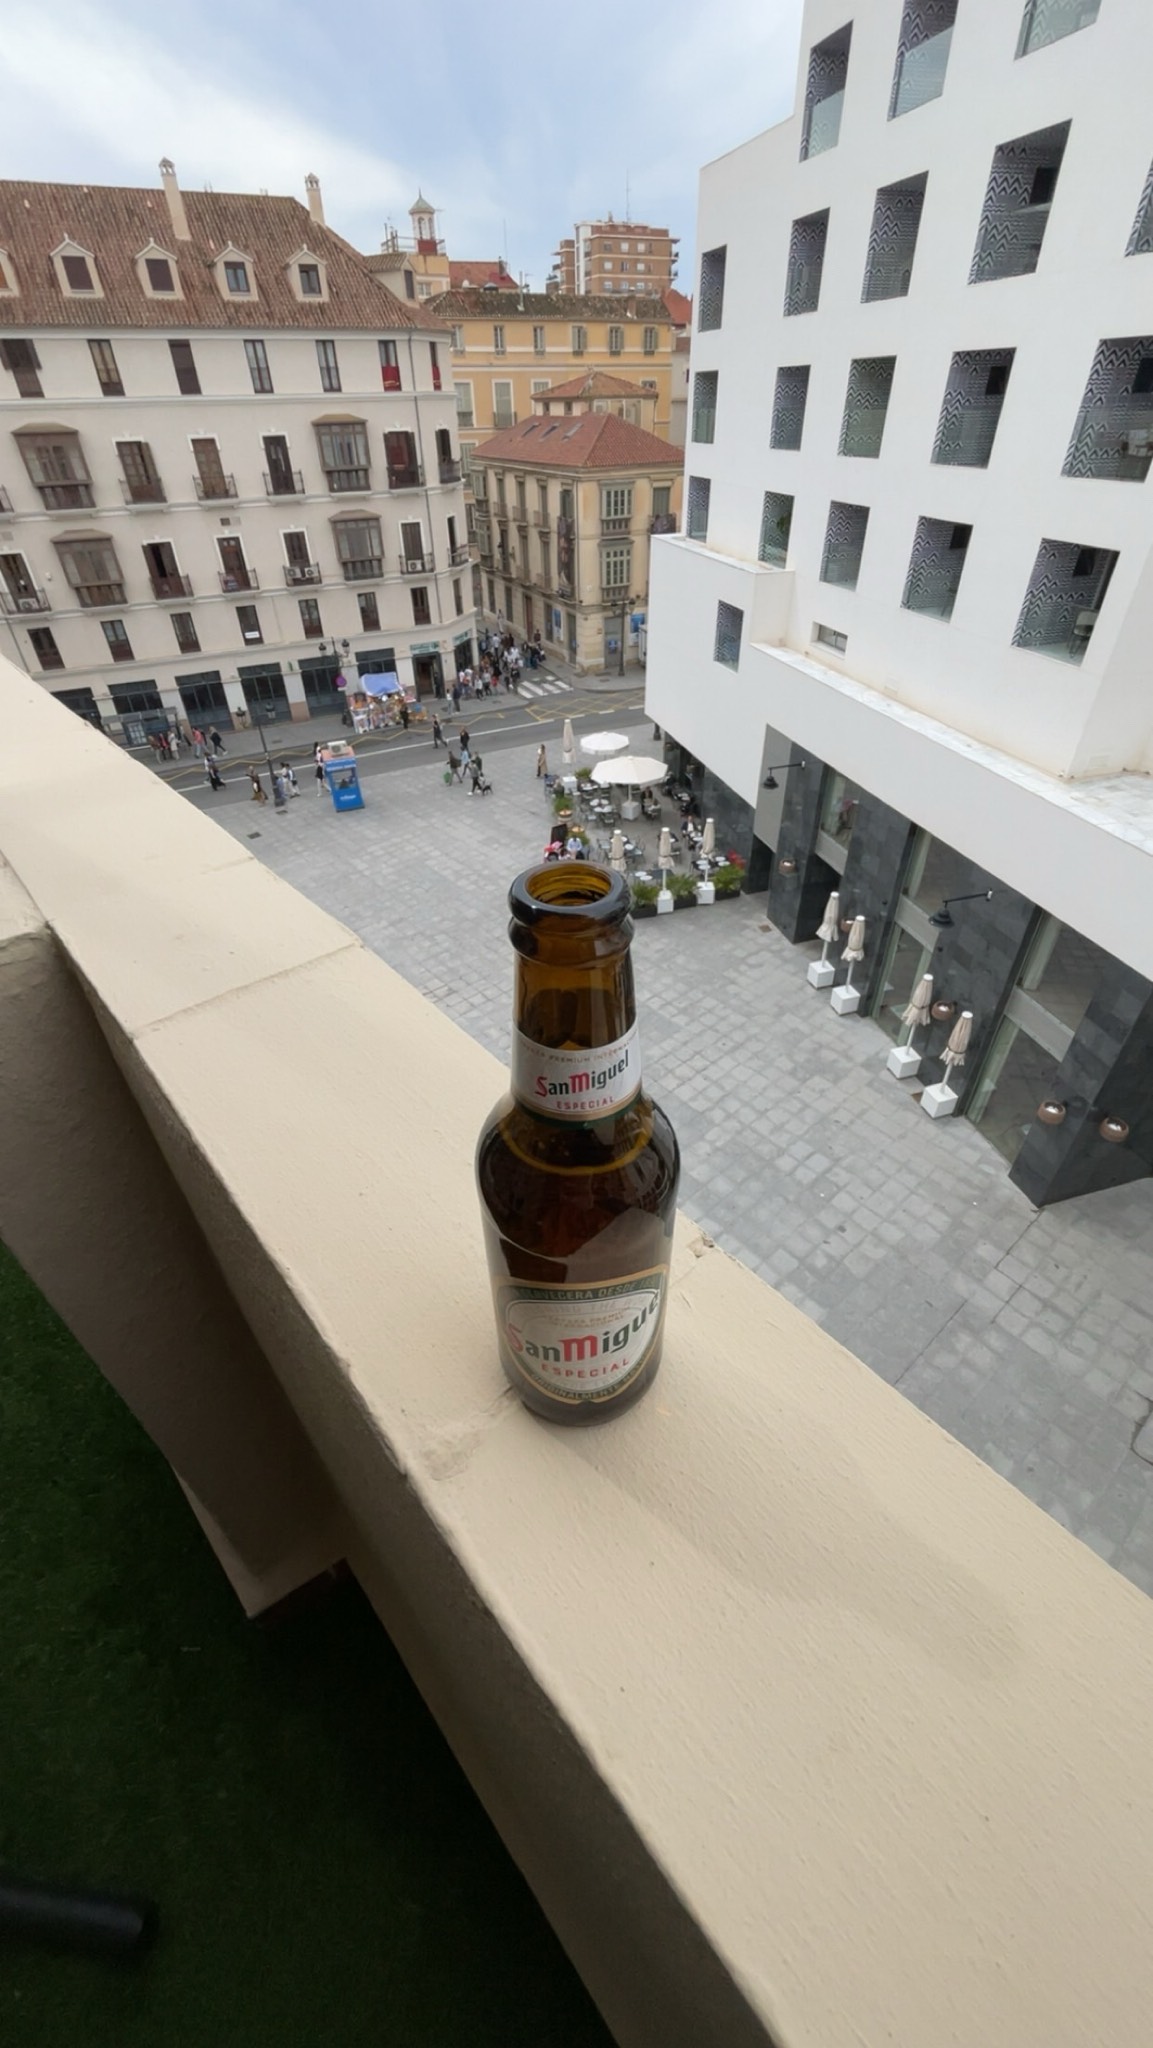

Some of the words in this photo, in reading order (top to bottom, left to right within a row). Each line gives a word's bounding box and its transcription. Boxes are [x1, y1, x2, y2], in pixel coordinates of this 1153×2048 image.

[556, 1096, 614, 1110] ESPECIAL
[598, 1281, 636, 1296] DESDE
[541, 1358, 629, 1379] ESPECIAL
